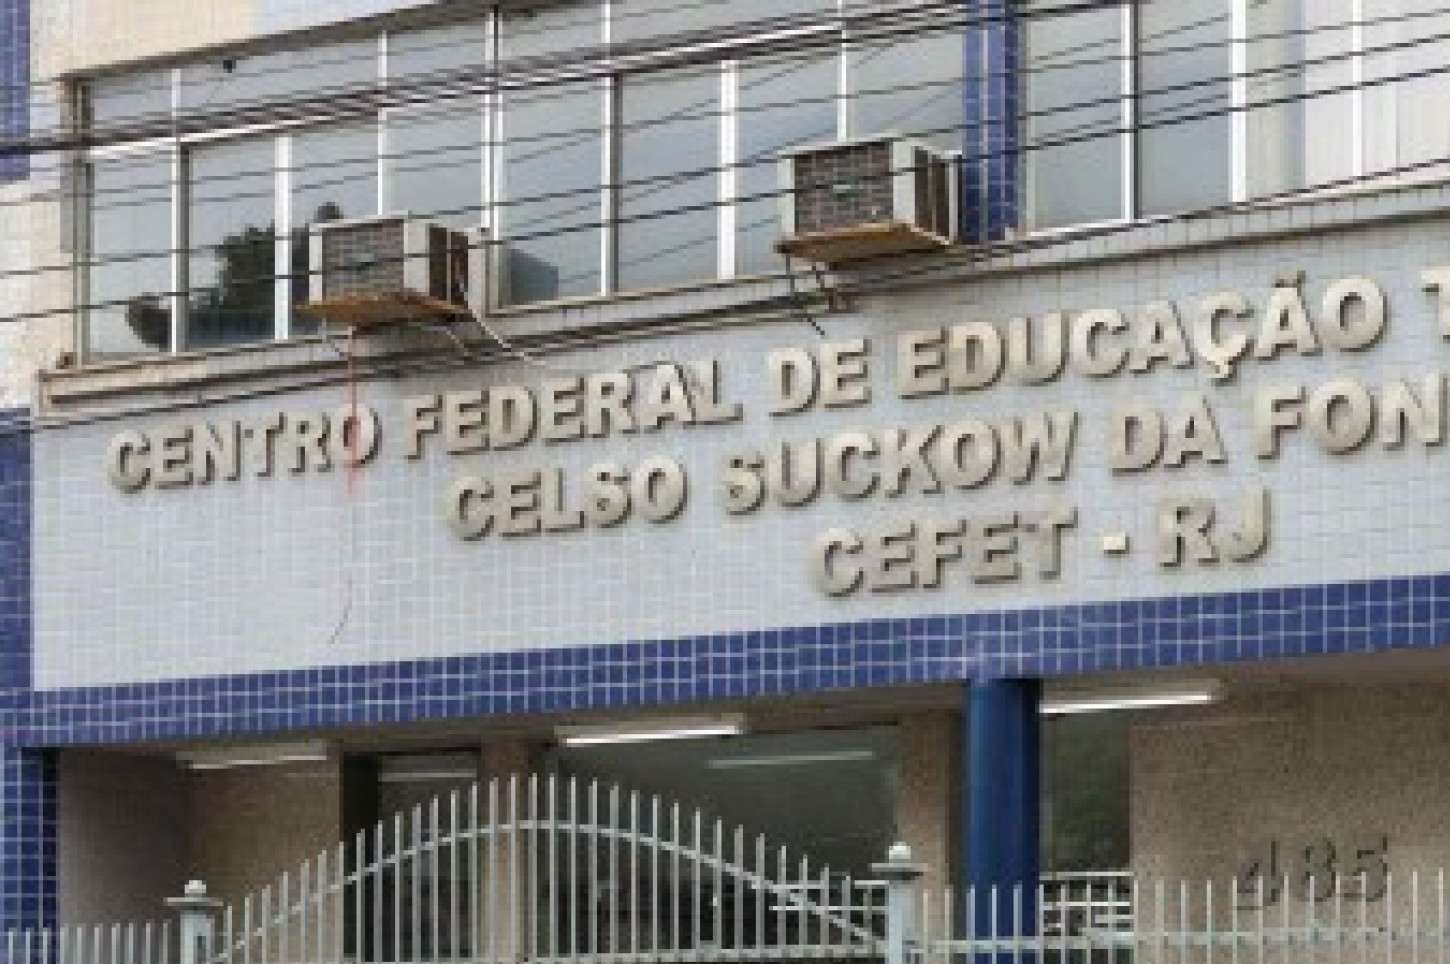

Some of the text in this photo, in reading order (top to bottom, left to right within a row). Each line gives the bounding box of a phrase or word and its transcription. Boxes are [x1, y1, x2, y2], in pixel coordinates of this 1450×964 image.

[107, 404, 382, 493] CENTRO
[404, 358, 743, 461] FEDERAL
[769, 338, 872, 418] DE
[897, 270, 1388, 399] EDUCAÇÃO
[449, 456, 689, 541] CELSO
[722, 409, 1080, 519] SUCKOW
[1110, 400, 1228, 475] DA
[814, 506, 1079, 597] CEFET
[1159, 486, 1272, 568] RJ
